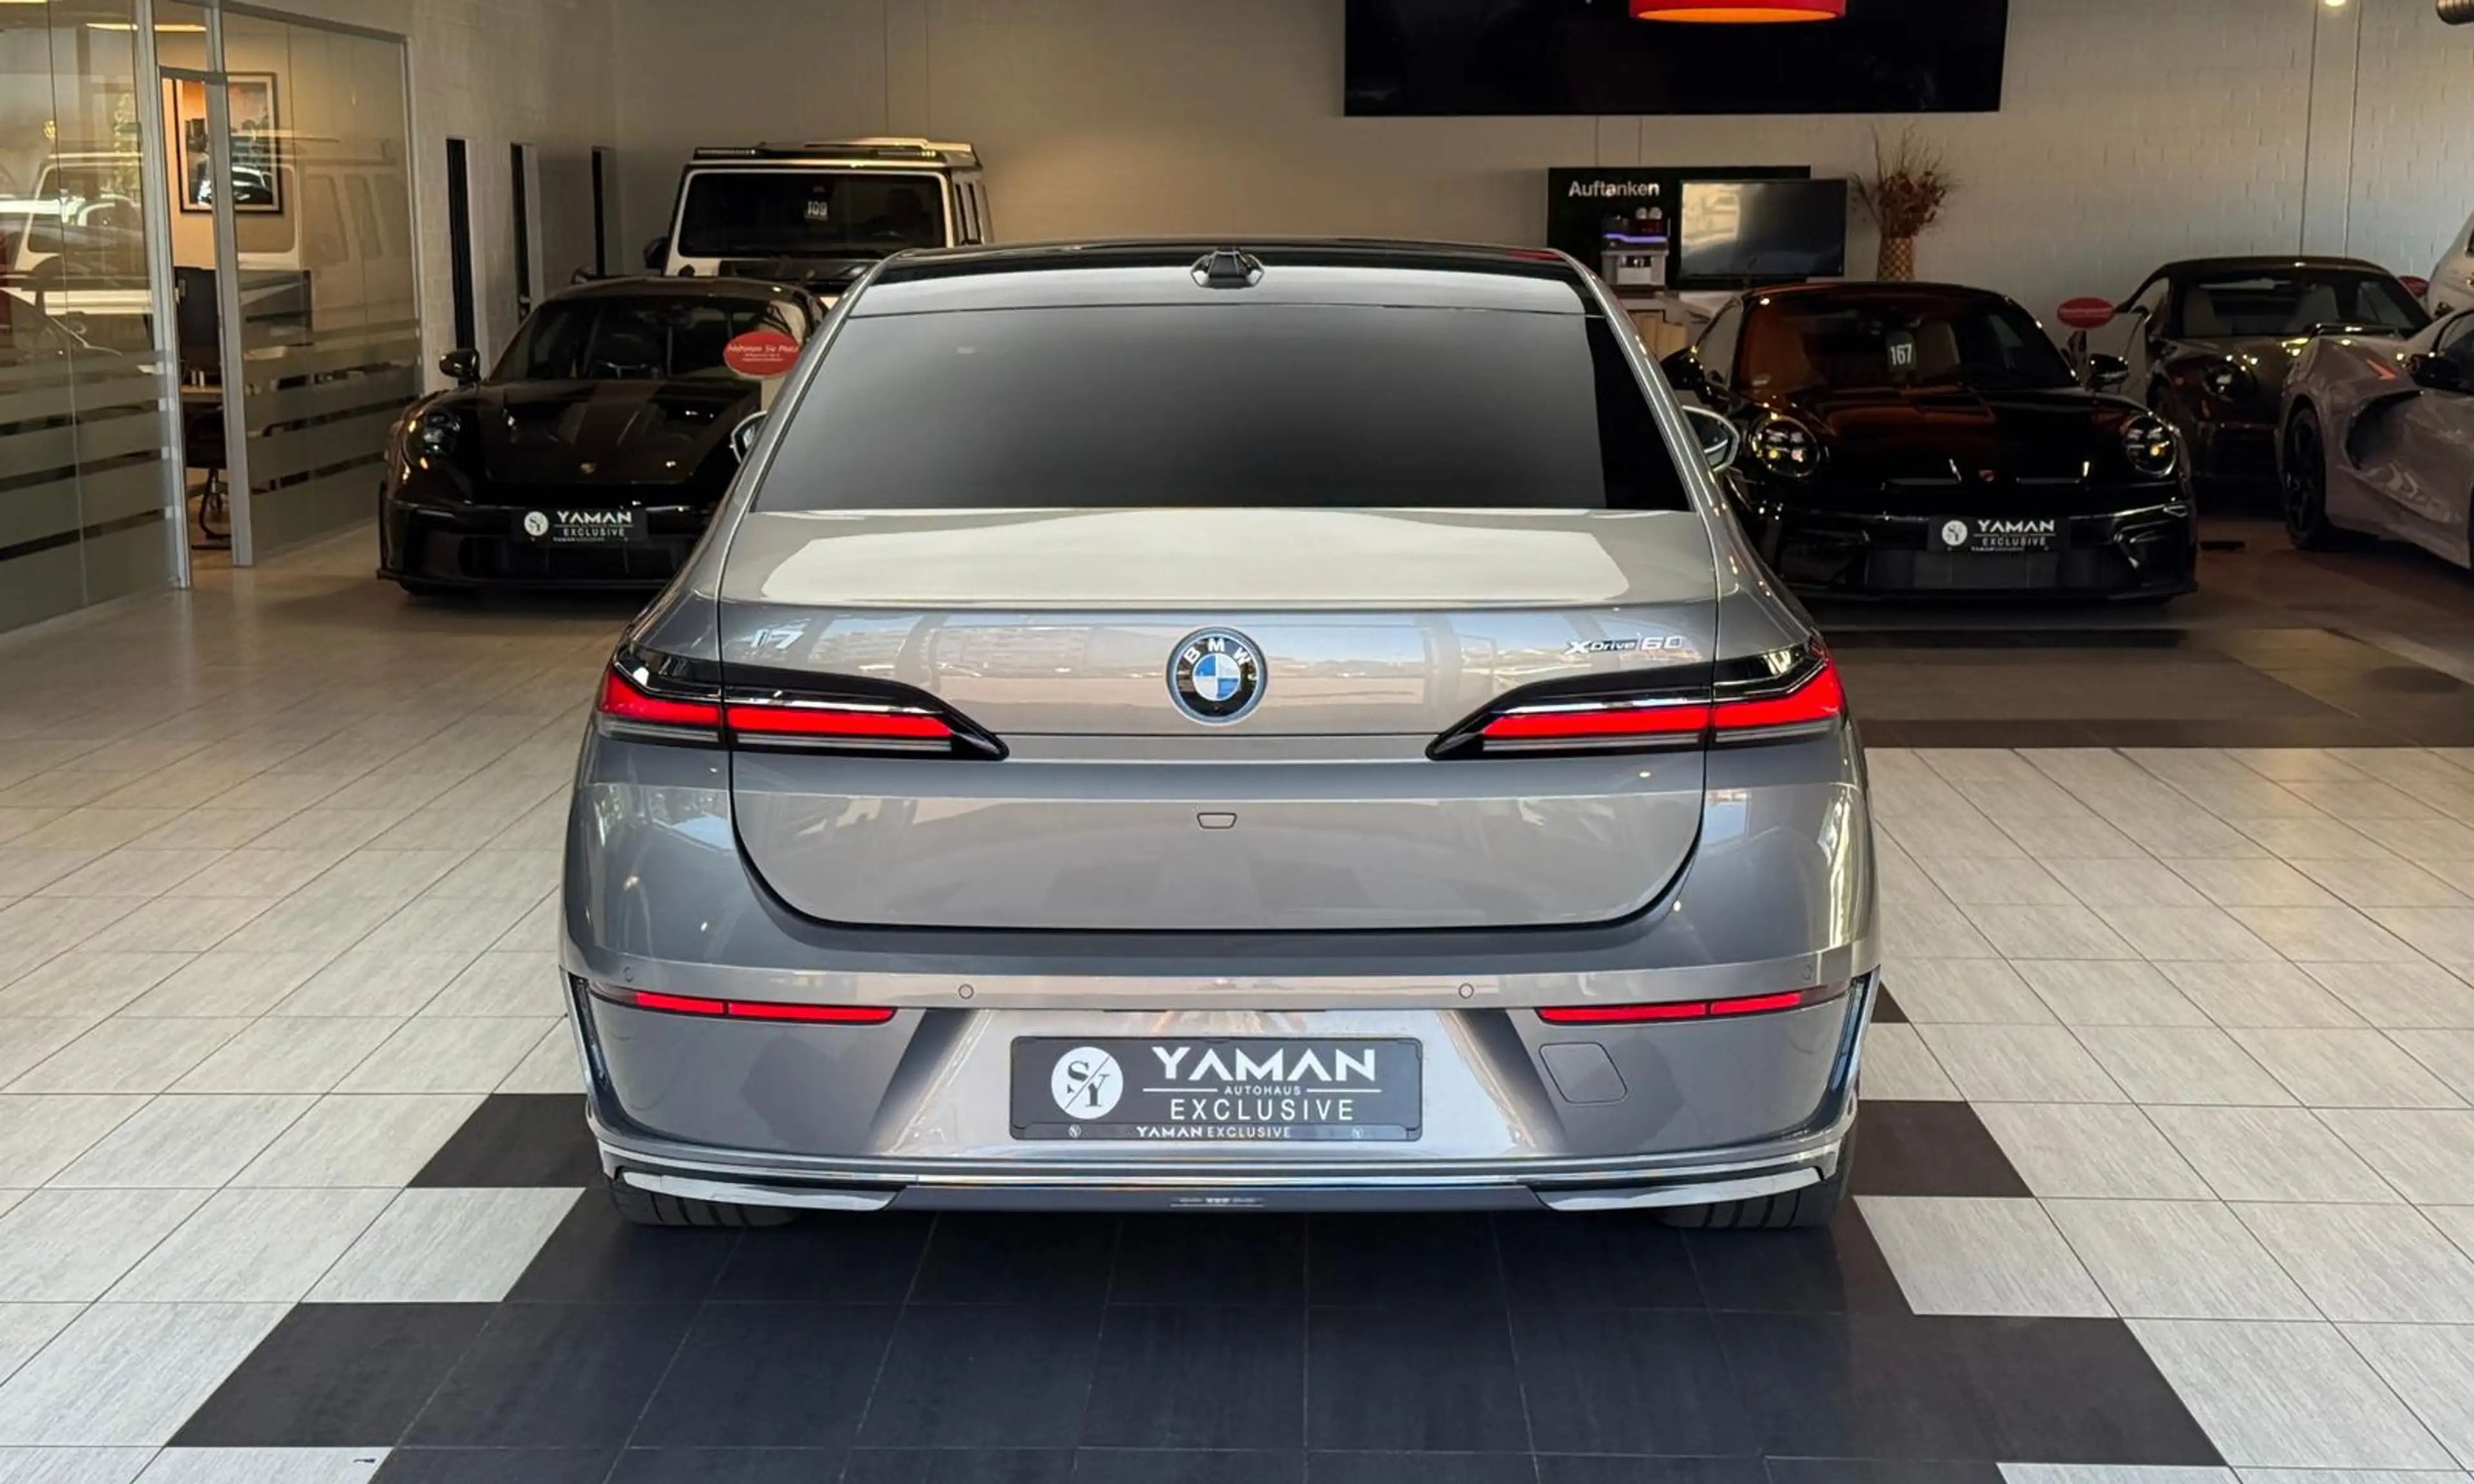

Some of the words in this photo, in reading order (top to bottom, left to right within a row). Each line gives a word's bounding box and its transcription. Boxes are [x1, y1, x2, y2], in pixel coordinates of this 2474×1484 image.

[1568, 180, 1660, 197] Auftanken
[1890, 343, 1912, 366] 167
[556, 510, 632, 524] YAMAN
[562, 528, 625, 537] EXCLUSIVE
[1977, 519, 2055, 533] YAMAN
[1982, 537, 2046, 546] EXCLUSIVE
[1183, 637, 1251, 665] BMW
[1151, 1047, 1376, 1082] YAMAN
[1225, 1085, 1302, 1096] AUTOHAUS
[1170, 1099, 1354, 1121] EXCLUSIVE
[1136, 1127, 1203, 1137] YAMAN
[1207, 1127, 1291, 1138] EXCLUSIVE
